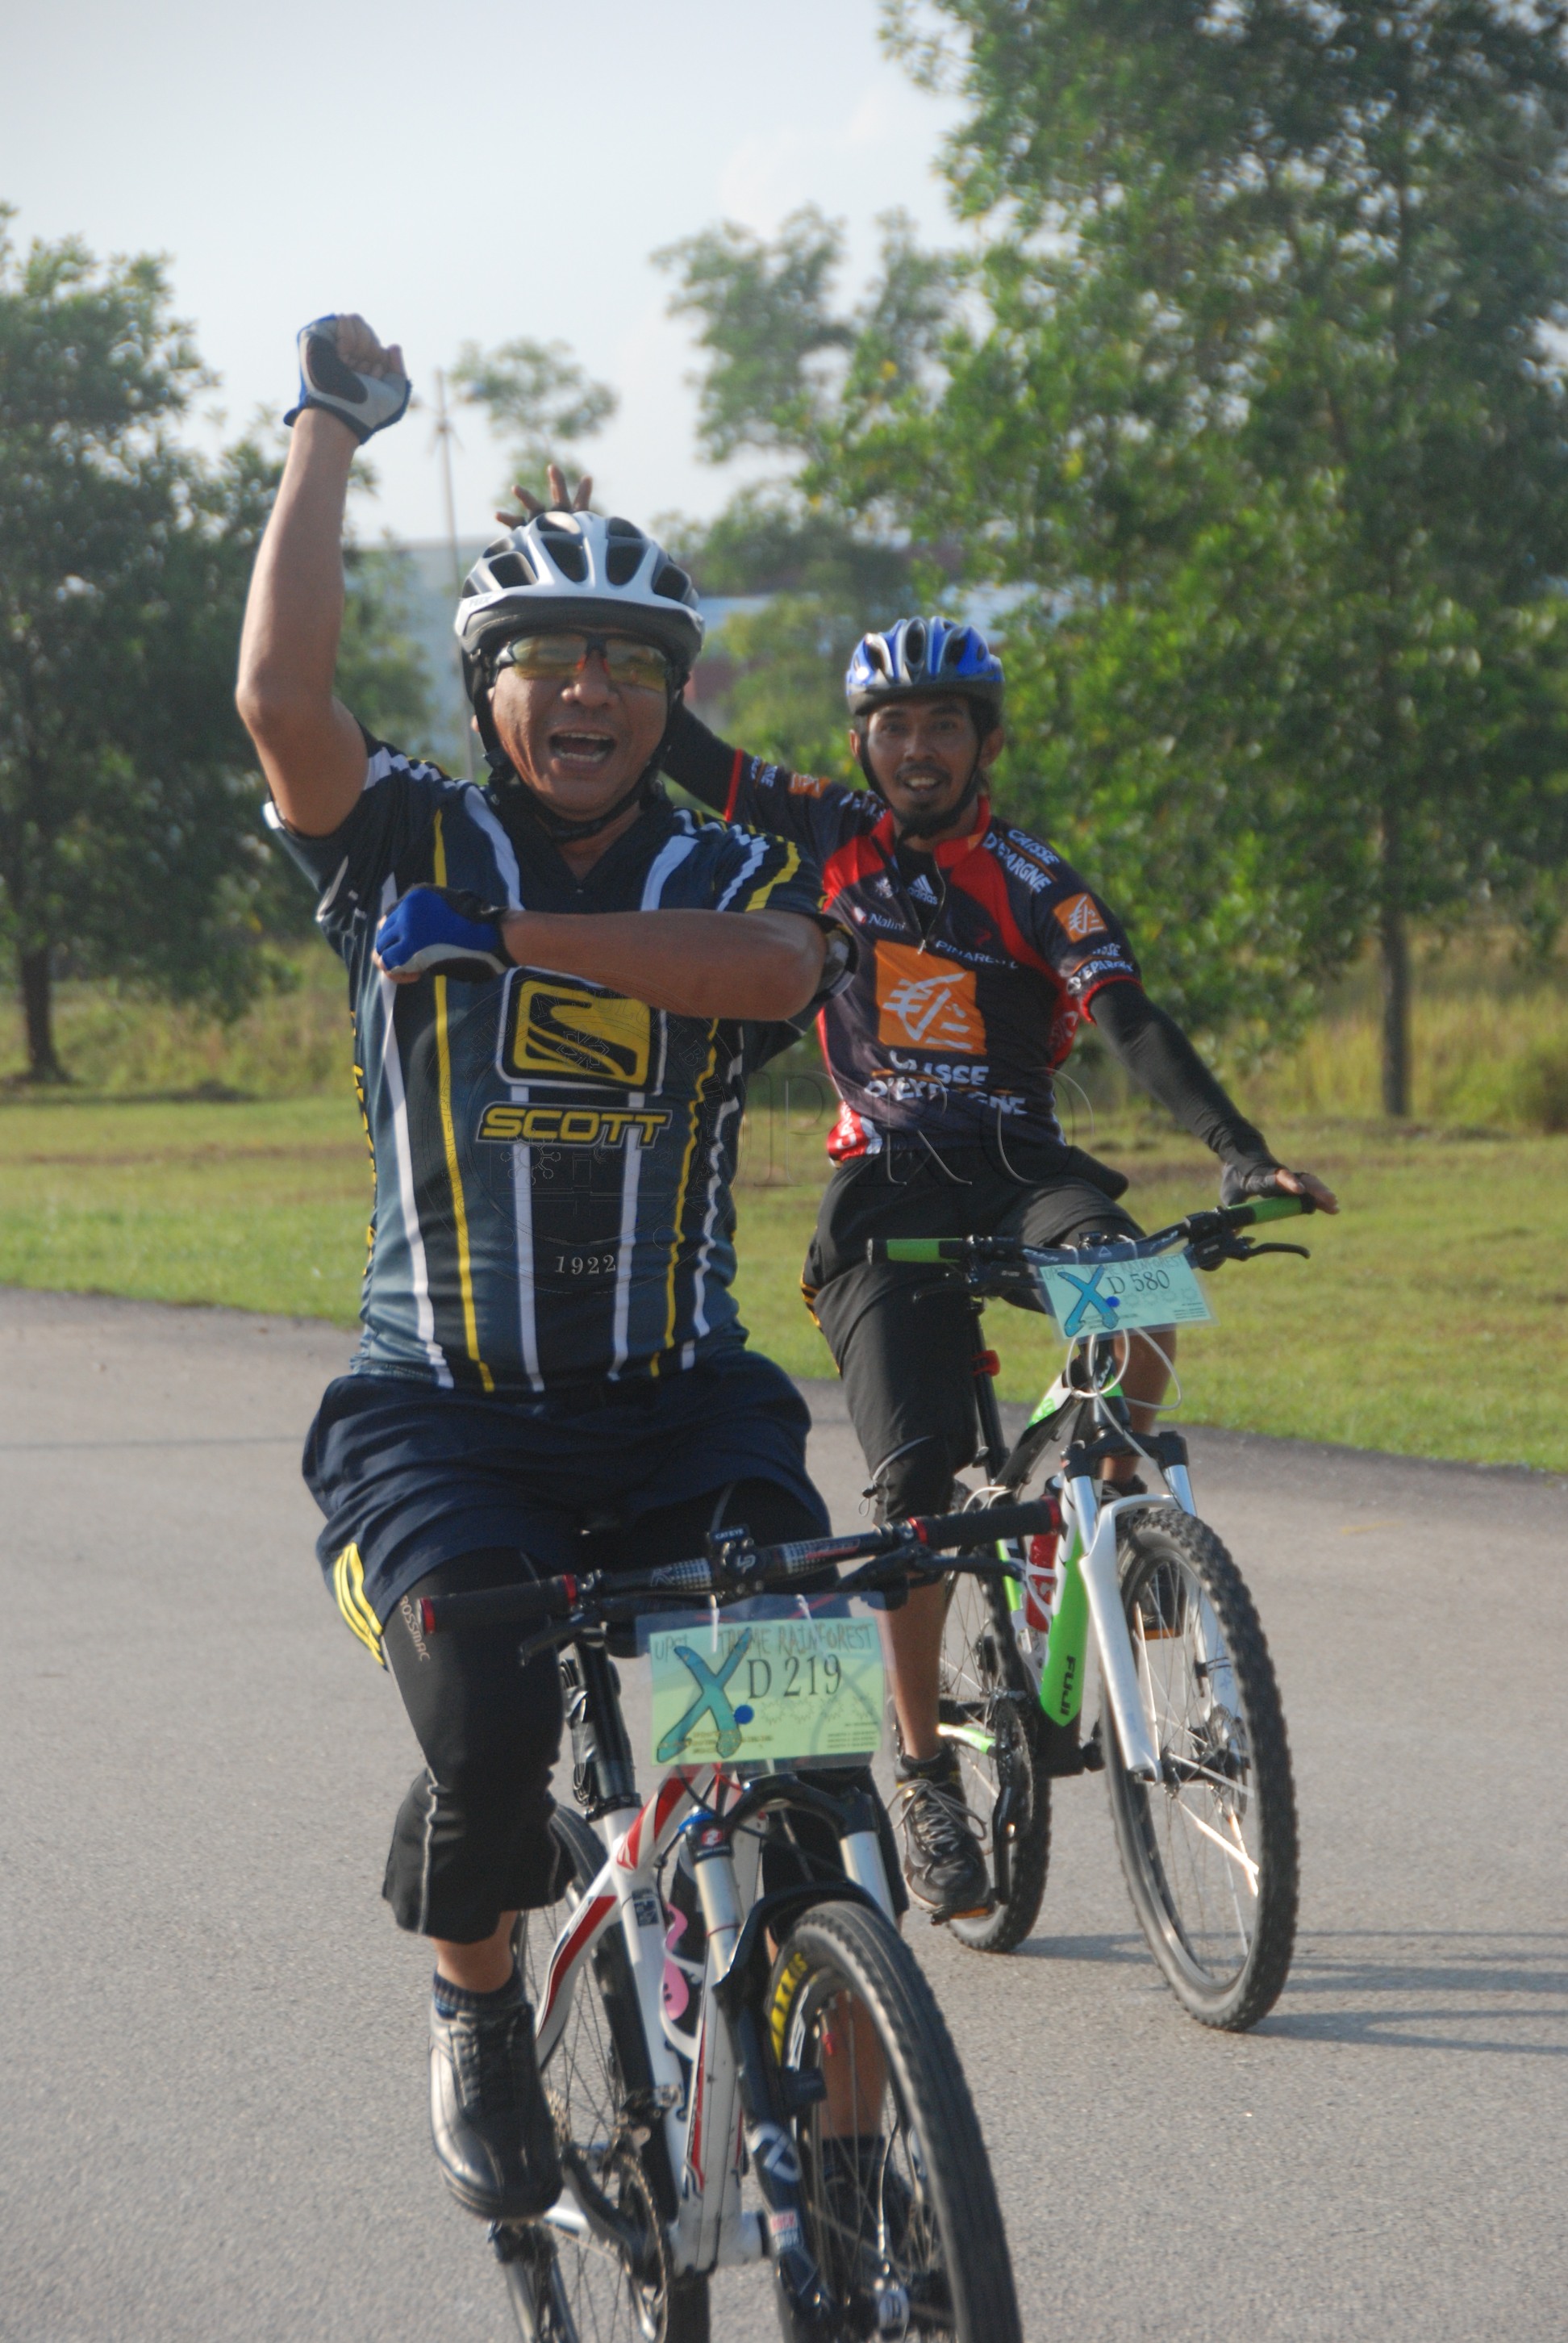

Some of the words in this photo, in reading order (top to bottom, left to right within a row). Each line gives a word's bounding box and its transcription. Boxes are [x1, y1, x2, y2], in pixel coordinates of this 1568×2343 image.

[907, 886, 939, 906] adidas
[868, 913, 906, 932] Nalini
[480, 1105, 670, 1146] SCOTT
[1106, 1276, 1126, 1295] D
[1132, 1269, 1170, 1293] 580
[748, 1658, 772, 1700] D
[783, 1653, 843, 1698] 219
[1060, 1655, 1077, 1717] FUJI
